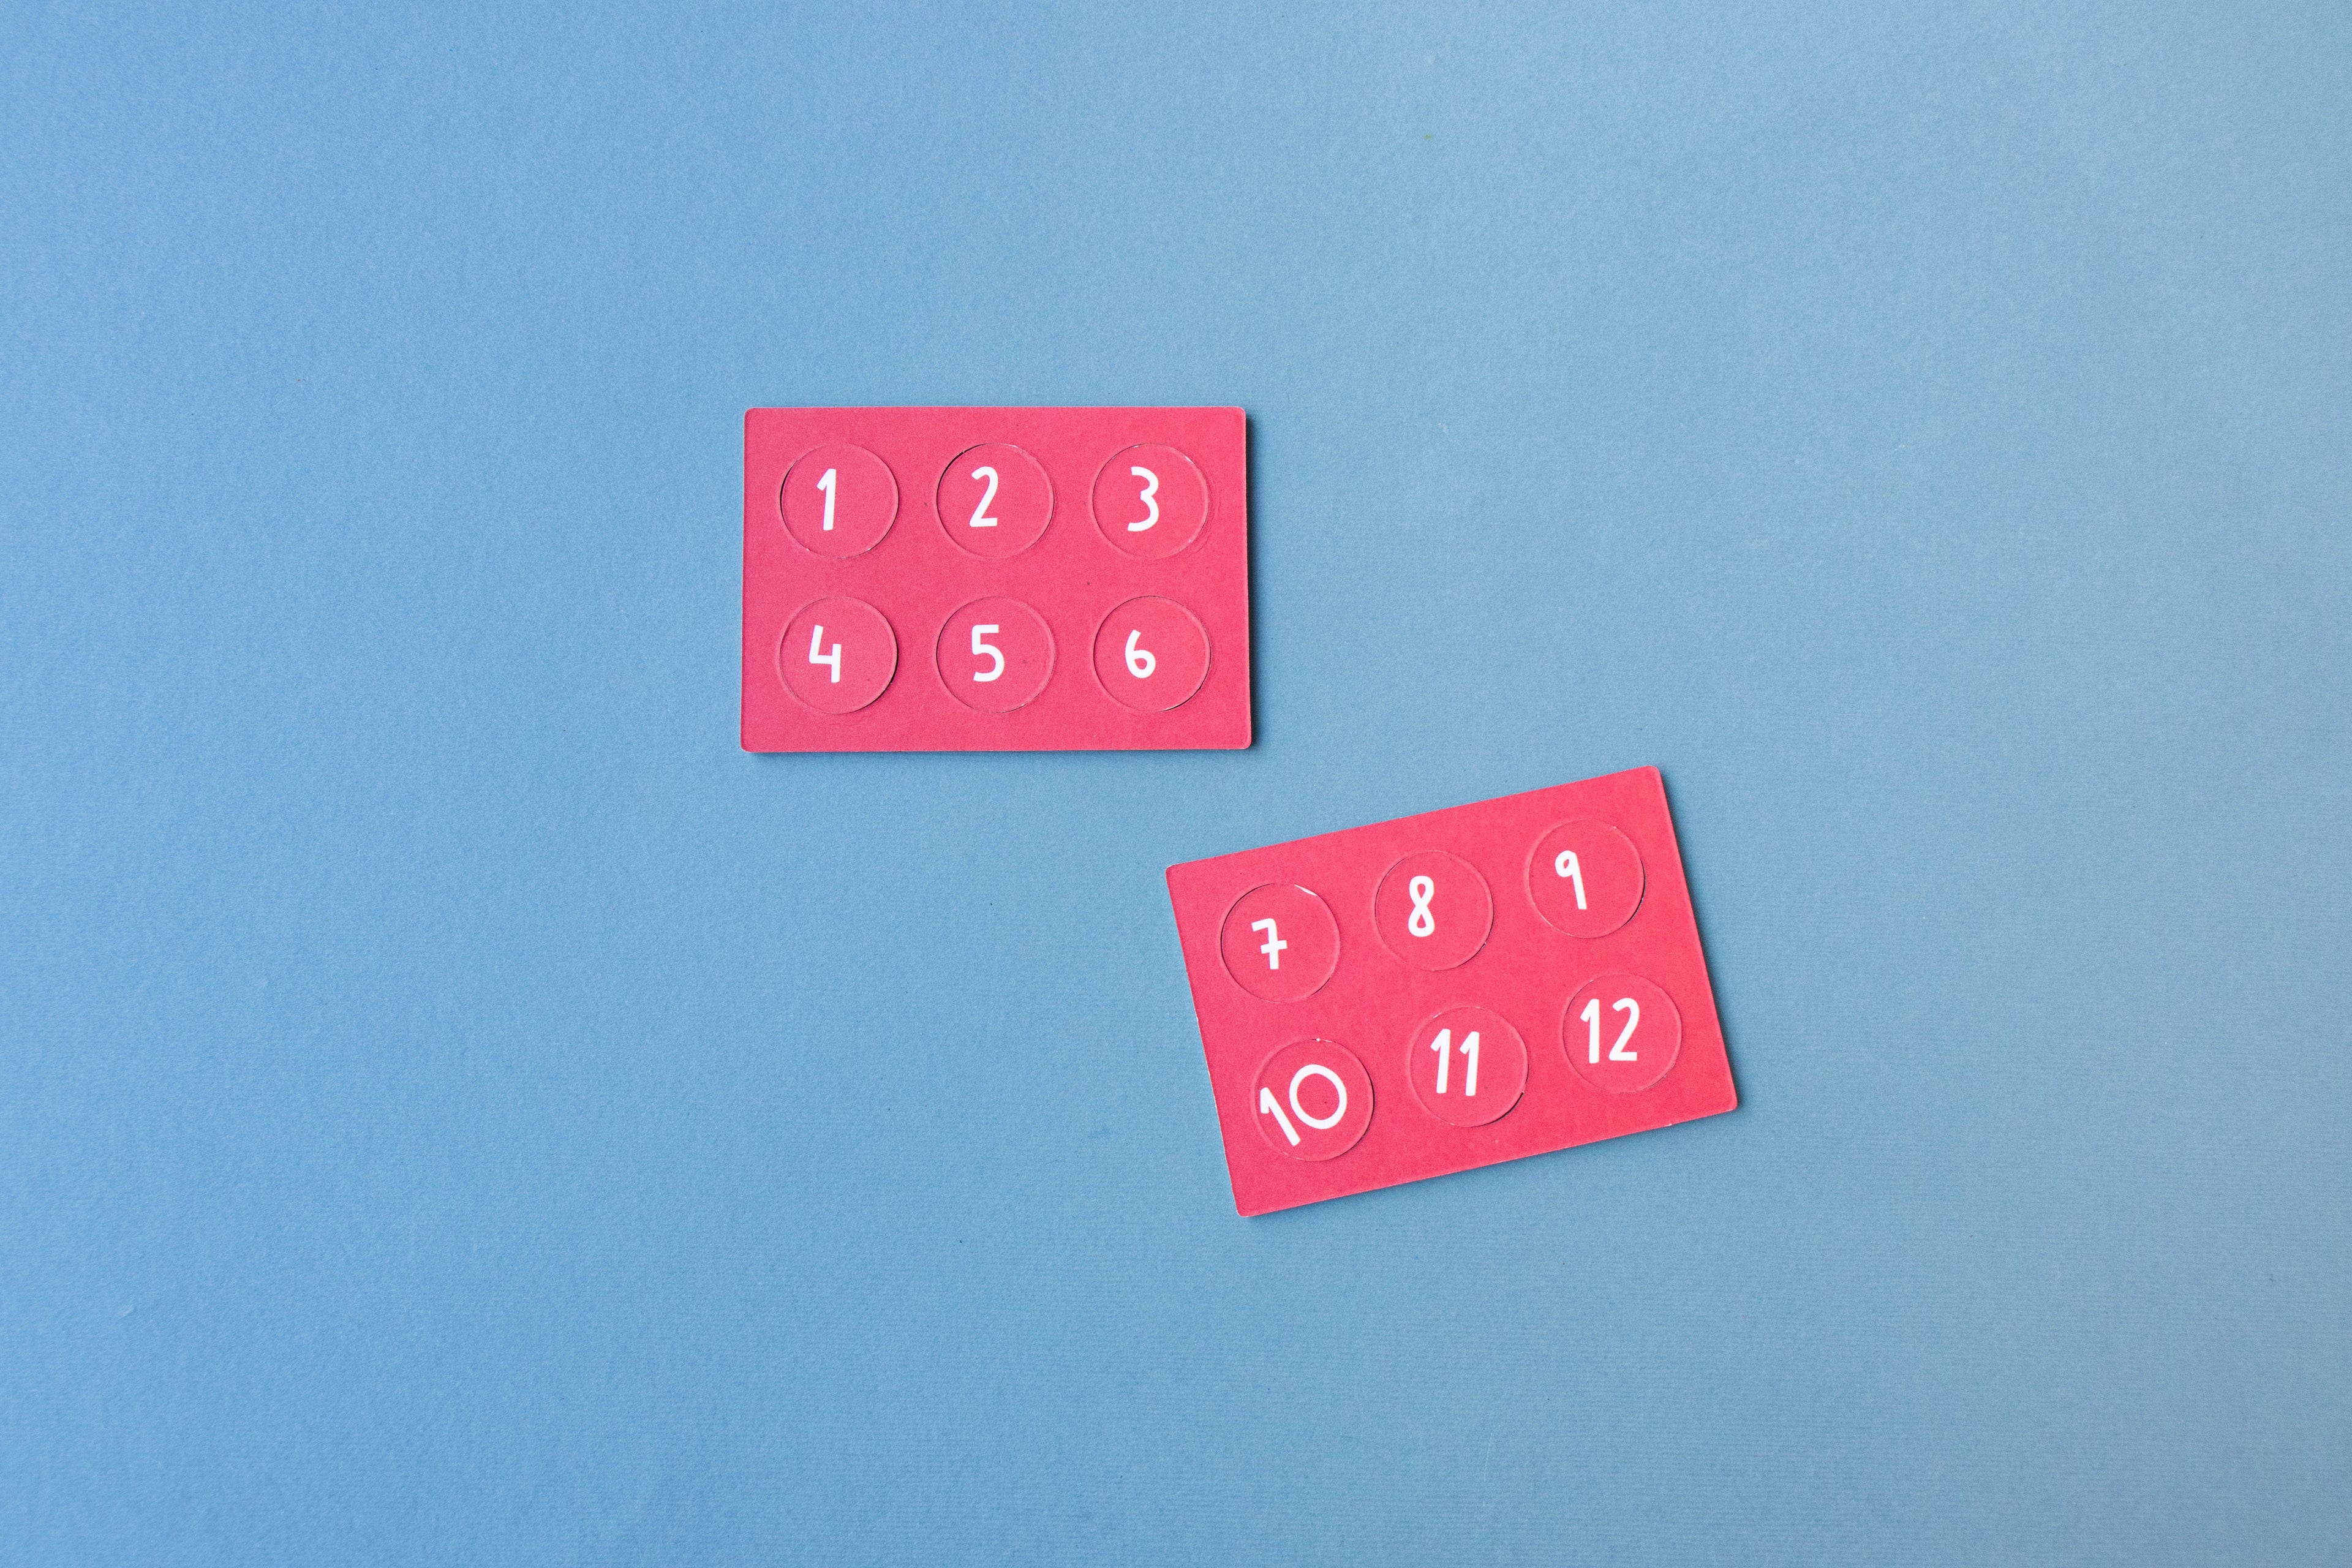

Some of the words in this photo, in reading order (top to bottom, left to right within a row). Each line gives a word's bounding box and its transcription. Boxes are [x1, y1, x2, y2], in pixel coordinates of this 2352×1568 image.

[816, 469, 837, 531] 1
[969, 466, 998, 527] 2
[1127, 466, 1159, 532] 3
[809, 625, 842, 684] 4
[971, 624, 1005, 682] 5
[1125, 629, 1156, 679] 6
[1251, 918, 1287, 970] 7
[1408, 875, 1435, 937] 8
[1555, 850, 1587, 910] 9
[1260, 1064, 1348, 1146] 10
[1430, 1028, 1480, 1096] 11
[1580, 998, 1640, 1064] 12
